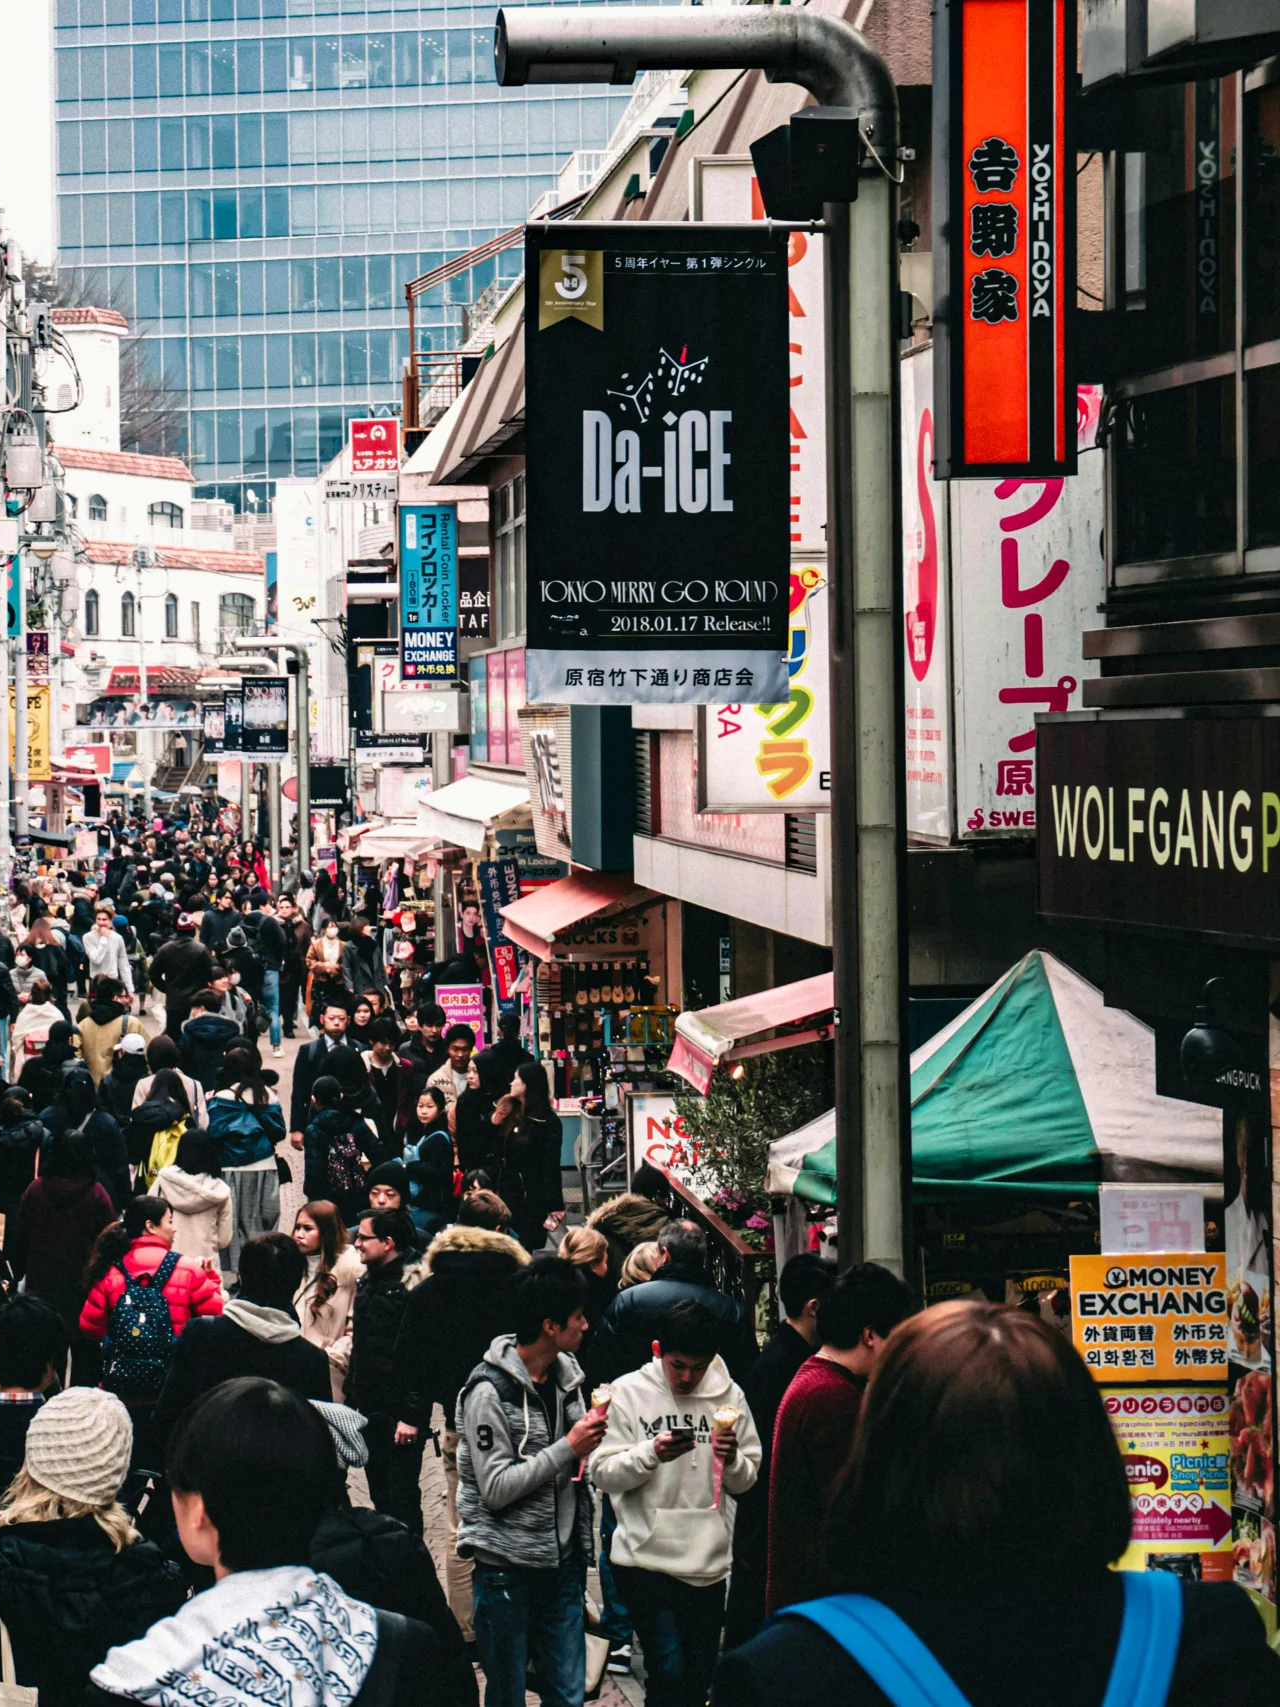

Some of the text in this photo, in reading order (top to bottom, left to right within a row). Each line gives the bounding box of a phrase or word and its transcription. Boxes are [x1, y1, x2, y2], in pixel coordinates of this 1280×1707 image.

[967, 136, 1020, 325] 吉野家
[1031, 142, 1052, 318] YOSHINOYA
[582, 409, 735, 514] Da-iCE
[352, 482, 396, 499] クリスティー
[420, 513, 438, 624] コインロッカー
[440, 513, 451, 624] Rental Coin Locker
[459, 590, 490, 608] 品企
[539, 579, 779, 603] TOKYO MERRY GO ROUND
[408, 613, 418, 623] 1F
[610, 615, 771, 632] 2018.01.17 Release!!
[404, 631, 454, 648] MONEY
[404, 650, 455, 662] EXCHANGE
[564, 667, 755, 687] 原宿竹下通り商店会
[9, 695, 42, 709] CFE
[1051, 784, 1254, 874] WOLFGANG
[1128, 1266, 1217, 1287] MONEY
[1078, 1291, 1227, 1317] EXCHANG
[1084, 1324, 1155, 1343] 外貨両替
[1084, 1348, 1156, 1368] 외화환전
[1106, 1398, 1224, 1413] プリクラ専門店
[665, 1413, 714, 1432] US.A.
[476, 1423, 495, 1452] 3
[1174, 1517, 1202, 1525] nearby
